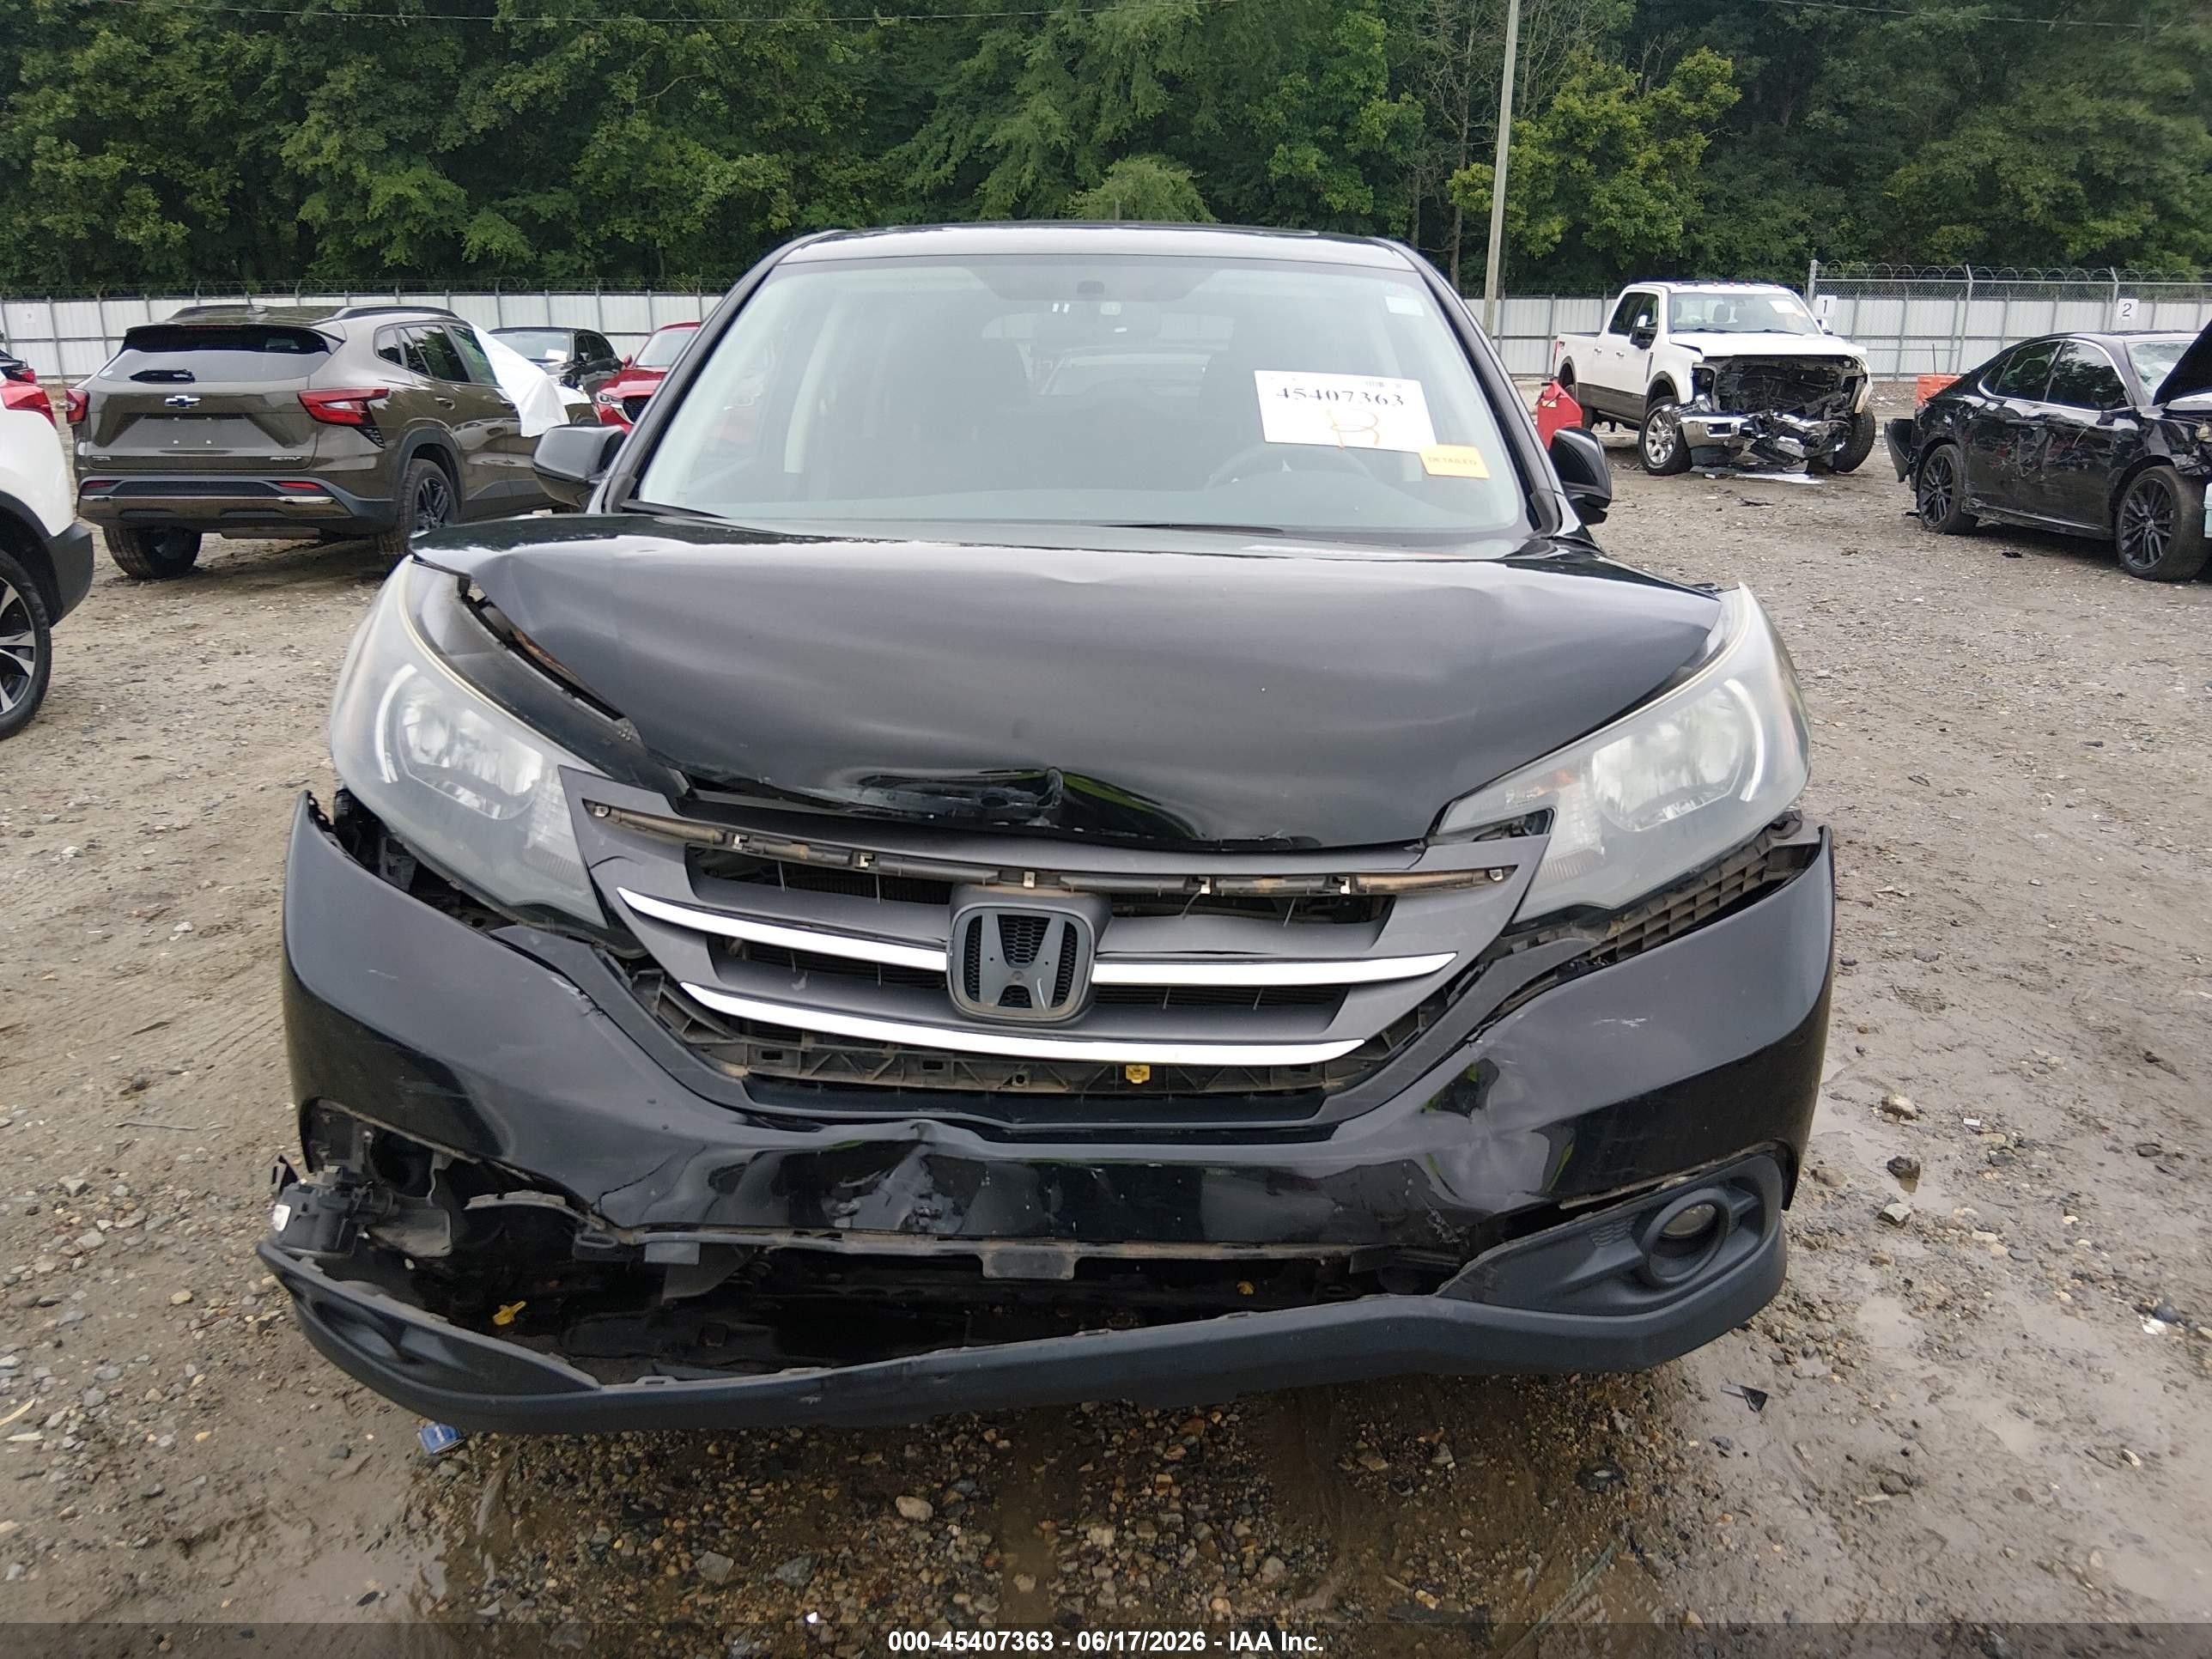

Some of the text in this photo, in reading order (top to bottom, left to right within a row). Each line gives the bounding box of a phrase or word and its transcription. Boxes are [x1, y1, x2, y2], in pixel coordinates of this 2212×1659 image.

[1823, 299, 1828, 314] 1
[2122, 302, 2132, 318] 2
[1276, 386, 1405, 407] 45407363
